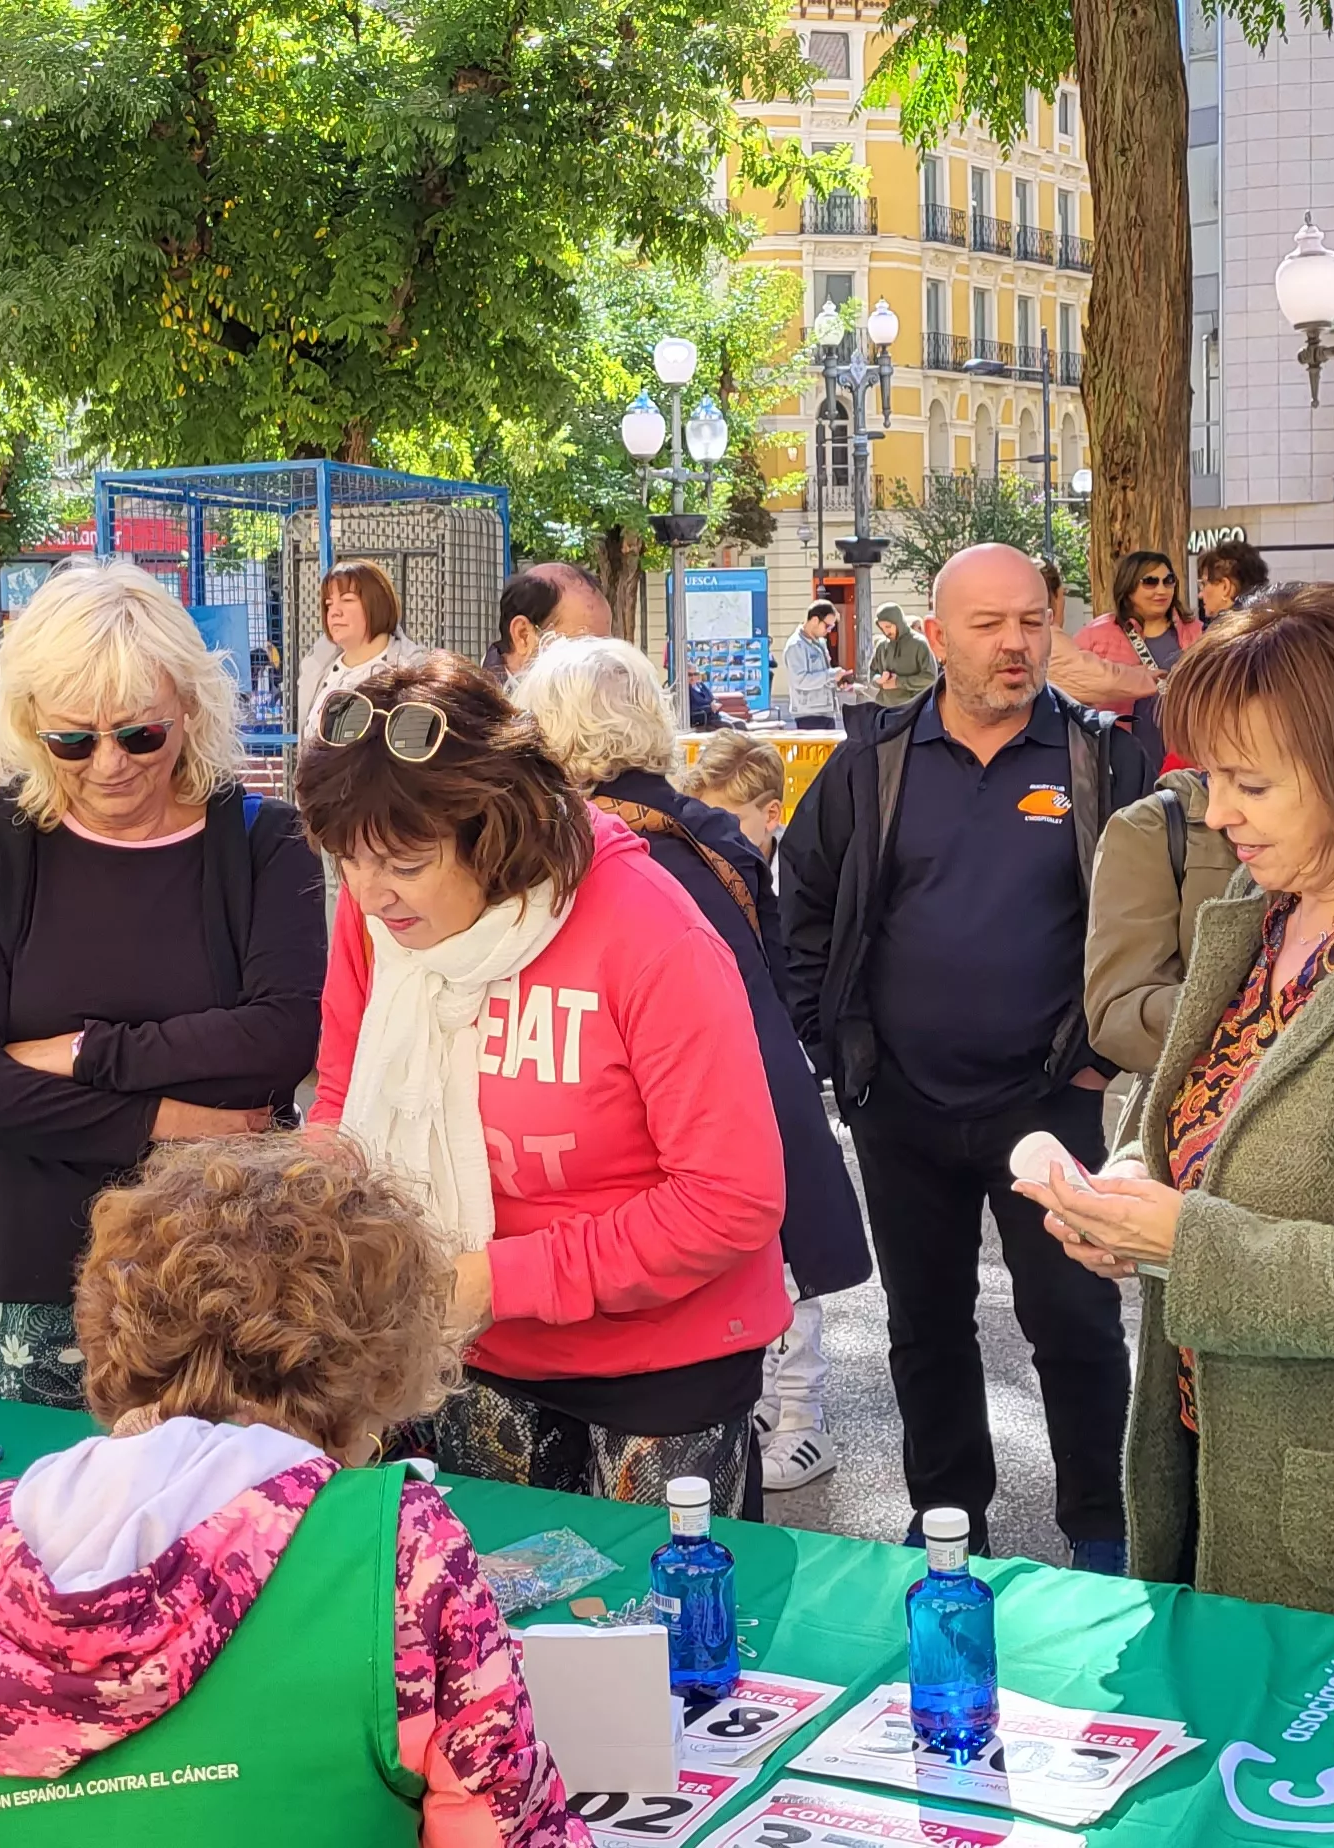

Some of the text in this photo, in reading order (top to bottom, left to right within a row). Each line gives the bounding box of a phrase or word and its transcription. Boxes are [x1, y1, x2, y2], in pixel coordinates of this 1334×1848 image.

[1187, 526, 1245, 553] MANGO
[684, 576, 718, 586] UESCA
[731, 1687, 798, 1708] NCER
[13, 1782, 85, 1807] ESPAÑOLA
[86, 1774, 148, 1795] CONTRA
[150, 1772, 170, 1787] EL
[171, 1763, 240, 1784] CÁNCER
[782, 1806, 885, 1836] CONTRA
[888, 1828, 917, 1841] EL
